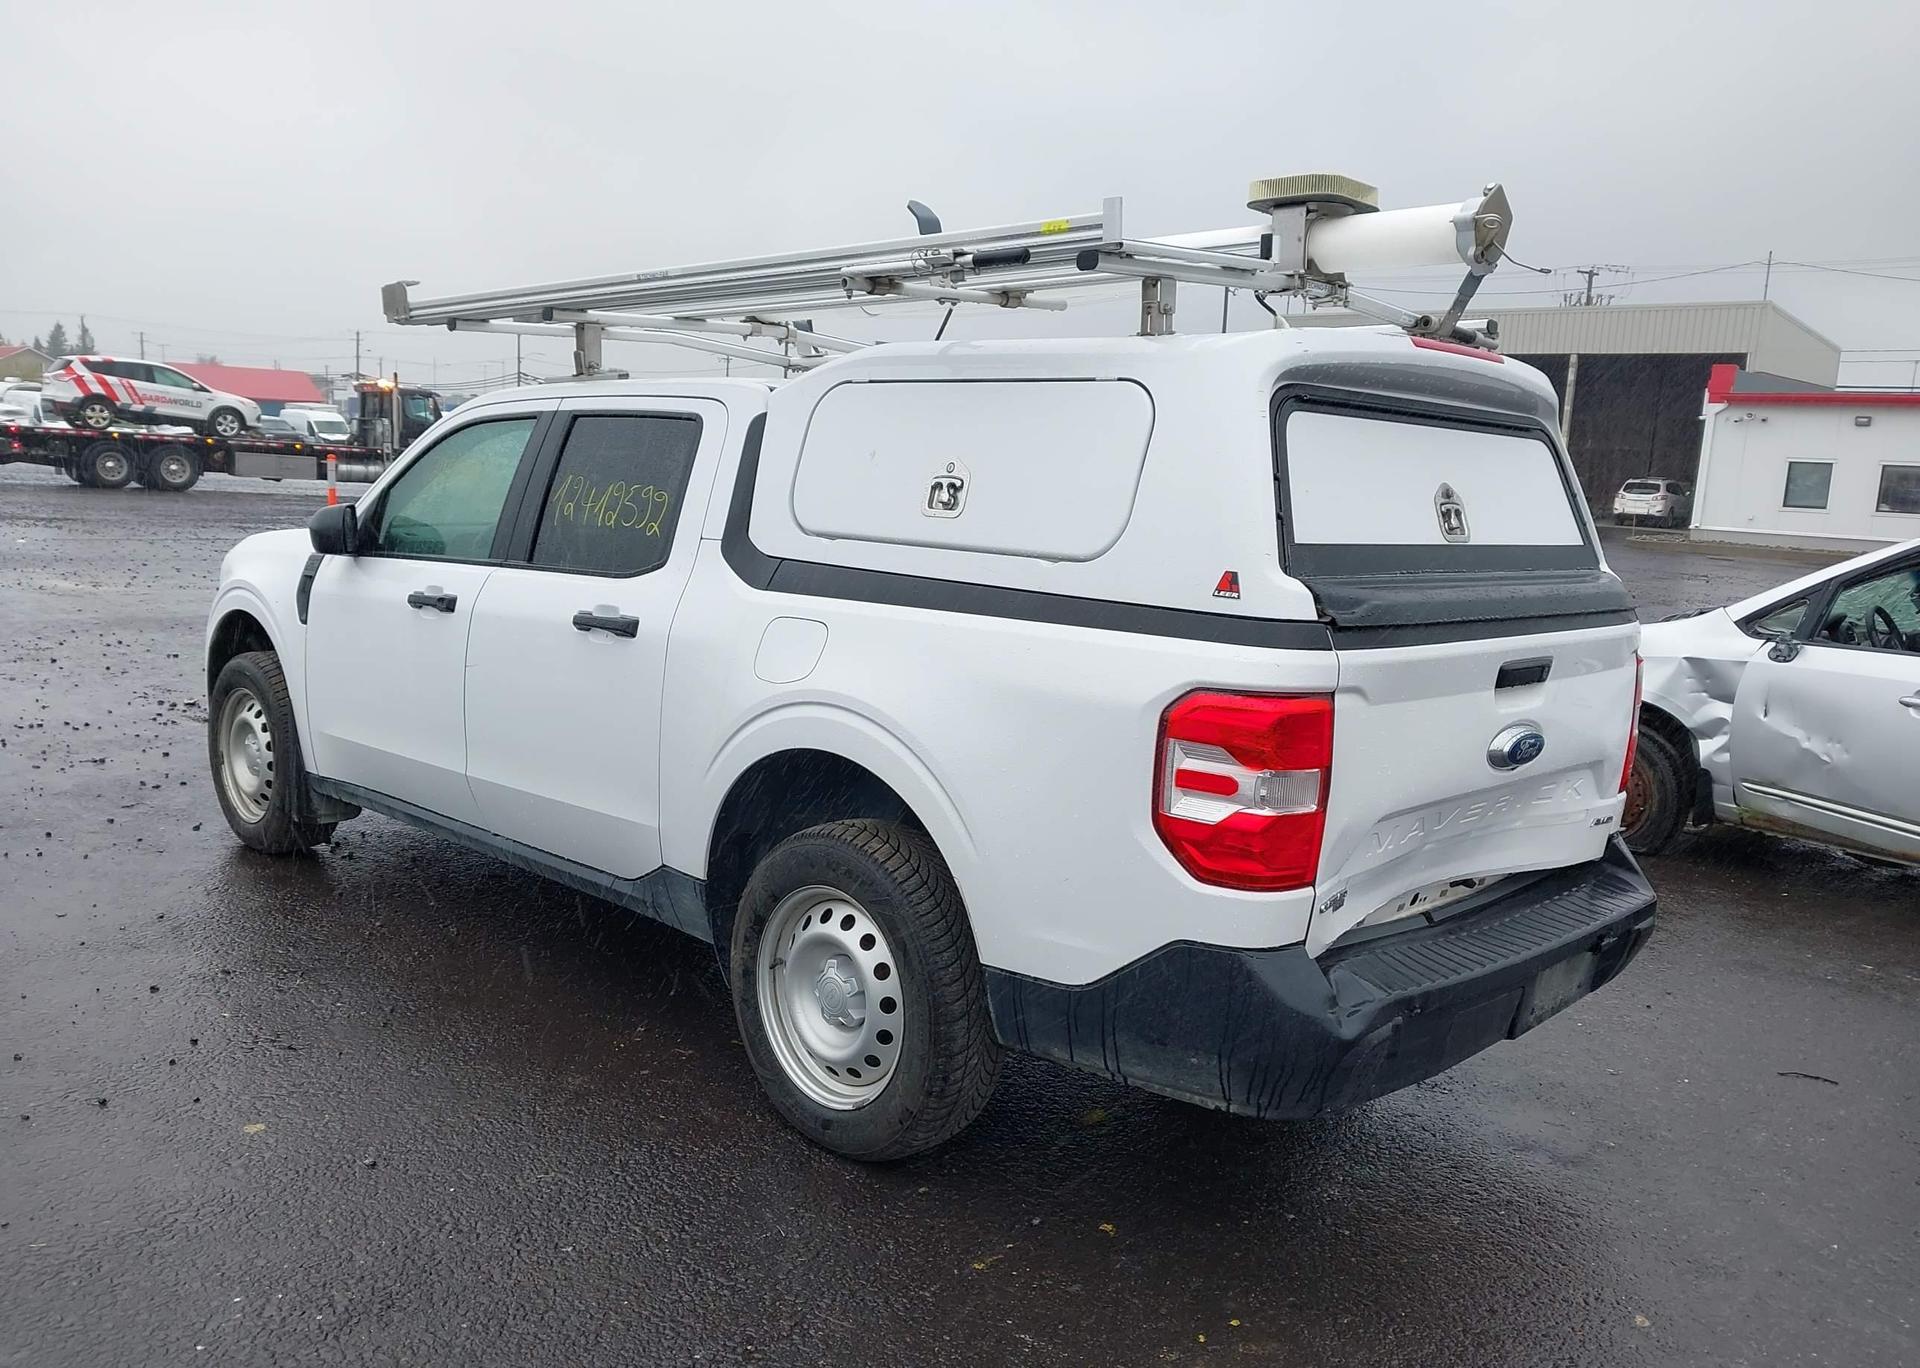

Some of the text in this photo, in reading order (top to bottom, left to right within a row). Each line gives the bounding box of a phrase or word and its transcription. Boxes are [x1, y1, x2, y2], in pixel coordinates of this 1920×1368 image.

[553, 474, 669, 538] 12412592
[1516, 738, 1541, 761] Ford
[1365, 778, 1585, 859] MAVERCK
